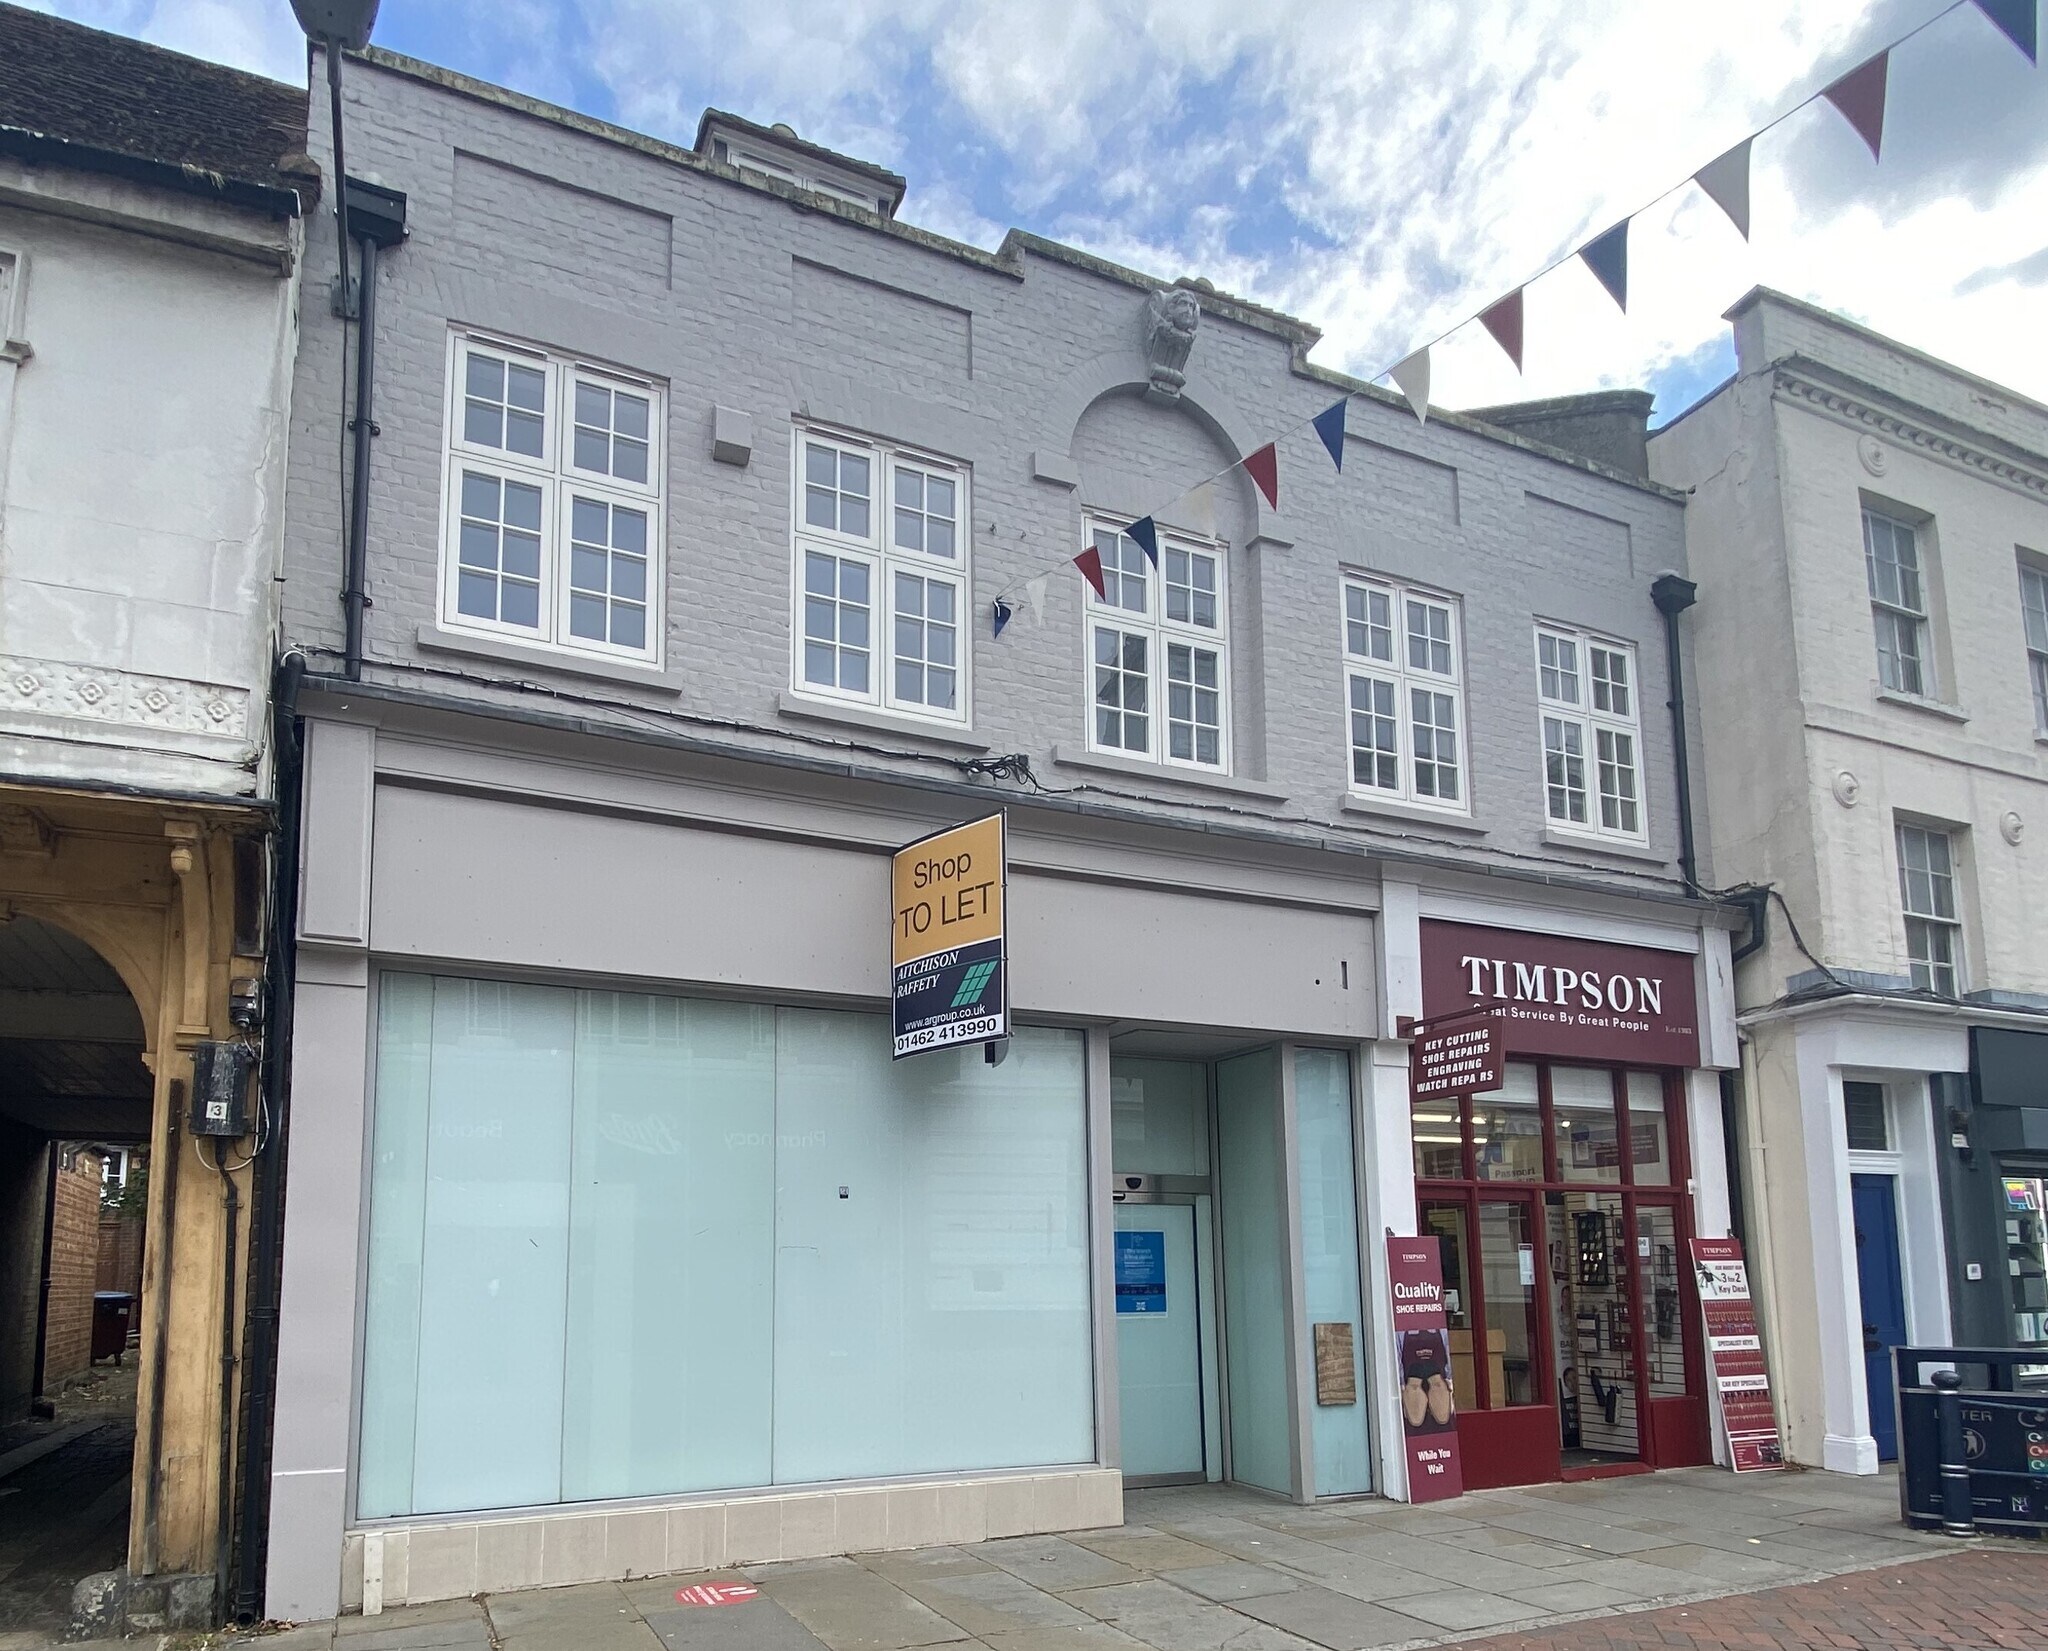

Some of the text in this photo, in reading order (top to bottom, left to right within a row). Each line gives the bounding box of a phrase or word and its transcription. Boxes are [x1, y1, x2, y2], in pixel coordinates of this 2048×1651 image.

[914, 853, 971, 889] Shop
[899, 881, 995, 938] TO LET
[896, 950, 960, 982] AITCHISON
[896, 973, 941, 999] RAFFETY
[1460, 954, 1663, 1015] TIMPSON
[903, 1003, 986, 1032] www.argroup.co.uk
[1511, 1007, 1556, 1022] Service
[1559, 1011, 1574, 1026] By
[1578, 1013, 1609, 1027] Great
[1612, 1017, 1650, 1032] People
[897, 1017, 997, 1051] 01462 413990
[1424, 1028, 1489, 1052] KEY CUTTING
[1421, 1042, 1491, 1066] SHOE REPAIRS
[1427, 1058, 1482, 1078] ENGRAVING
[1416, 1078, 1448, 1093] WATCH
[1494, 1166, 1536, 1179] Passport
[1720, 1272, 1727, 1283] 3
[1735, 1272, 1742, 1283] 2
[1394, 1281, 1441, 1301] Quality
[1718, 1285, 1747, 1294] Key Deal
[1395, 1303, 1443, 1314] SHOE REPAIRS
[1934, 1408, 1993, 1422] LTER
[1417, 1448, 1451, 1462] While You
[1427, 1463, 1445, 1475] Wait
